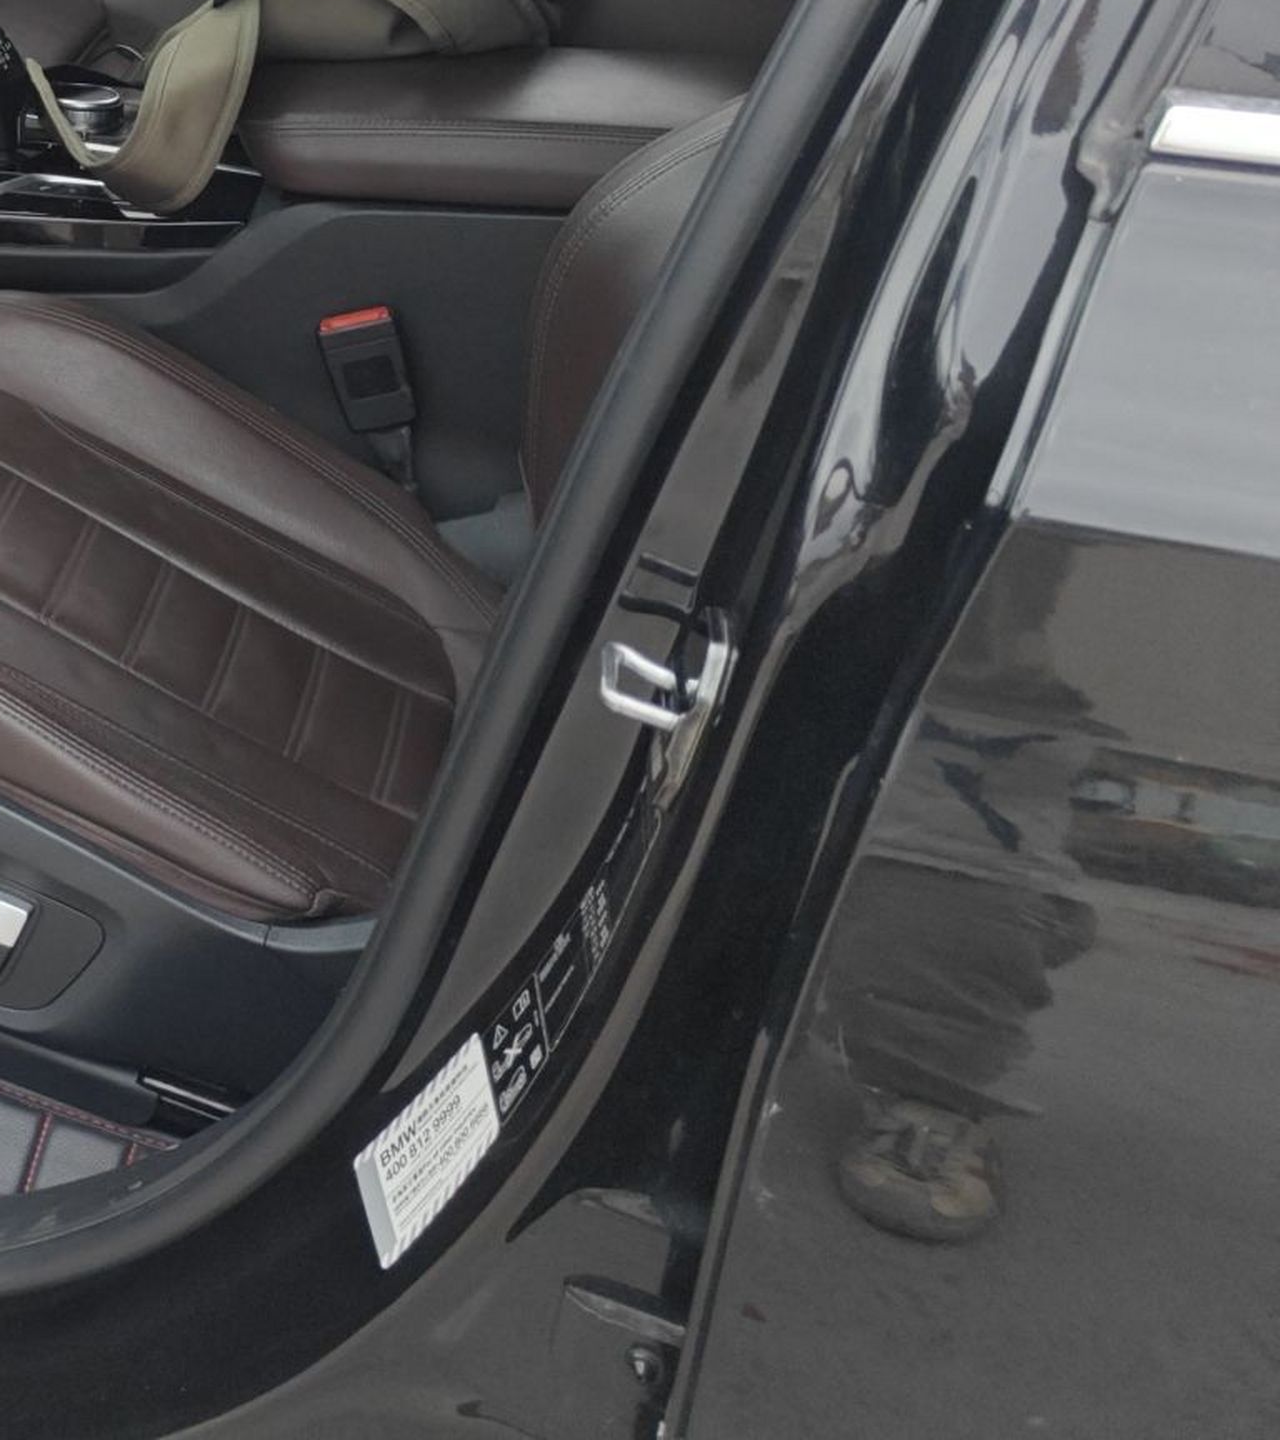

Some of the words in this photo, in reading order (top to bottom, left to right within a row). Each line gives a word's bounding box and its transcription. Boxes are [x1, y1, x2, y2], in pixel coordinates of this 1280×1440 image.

[380, 1120, 417, 1168] BMW
[385, 1154, 408, 1181] 400
[409, 1128, 430, 1158] 812
[432, 1094, 461, 1132] 9999
